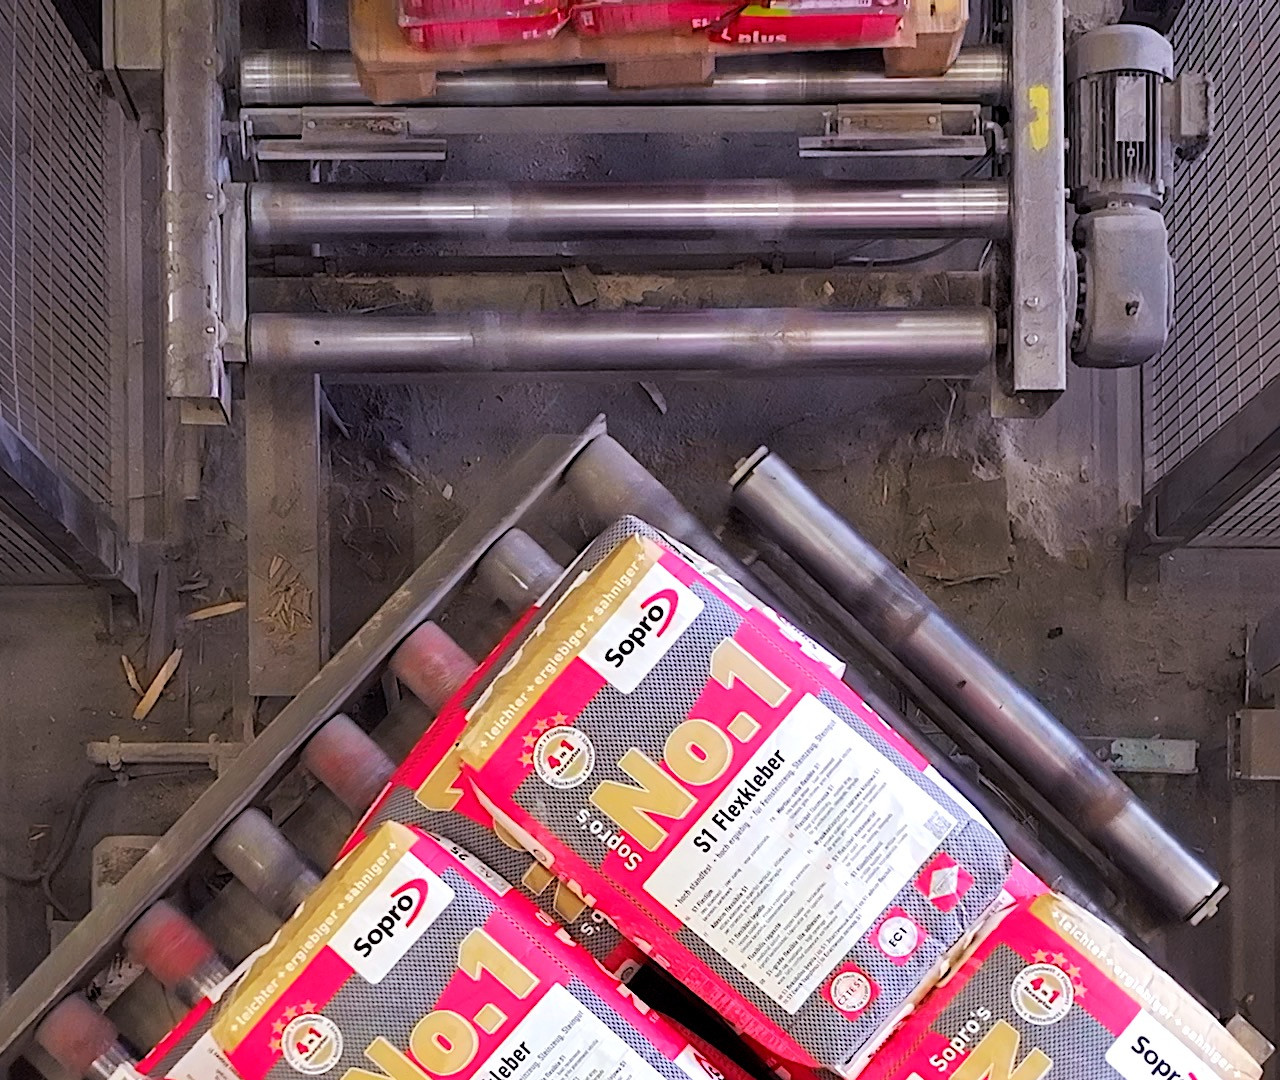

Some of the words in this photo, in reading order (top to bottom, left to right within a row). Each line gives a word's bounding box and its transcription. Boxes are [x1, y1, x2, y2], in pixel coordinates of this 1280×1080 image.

[484, 692, 528, 740] leichter
[534, 622, 595, 685] ergiebiger
[593, 561, 648, 616] sahniger
[604, 598, 673, 668] Sopro
[543, 753, 562, 771] 4
[559, 738, 575, 754] 1
[589, 637, 792, 851] No.1
[693, 828, 718, 853] S1
[711, 749, 785, 831] Flexkleber
[577, 807, 642, 872] Sopro's
[714, 844, 730, 859] hoch
[728, 821, 751, 845] ergiebig
[676, 889, 691, 904] hoch
[689, 863, 712, 890] standfest
[235, 978, 279, 1025] leichter
[284, 910, 338, 972] ergiebiger
[344, 849, 390, 903] sahniger
[353, 889, 422, 958] Sopro
[1058, 914, 1110, 959] leichter
[1028, 974, 1045, 992] 4
[1046, 989, 1060, 1004] 1
[928, 1006, 991, 1072] Sopro's
